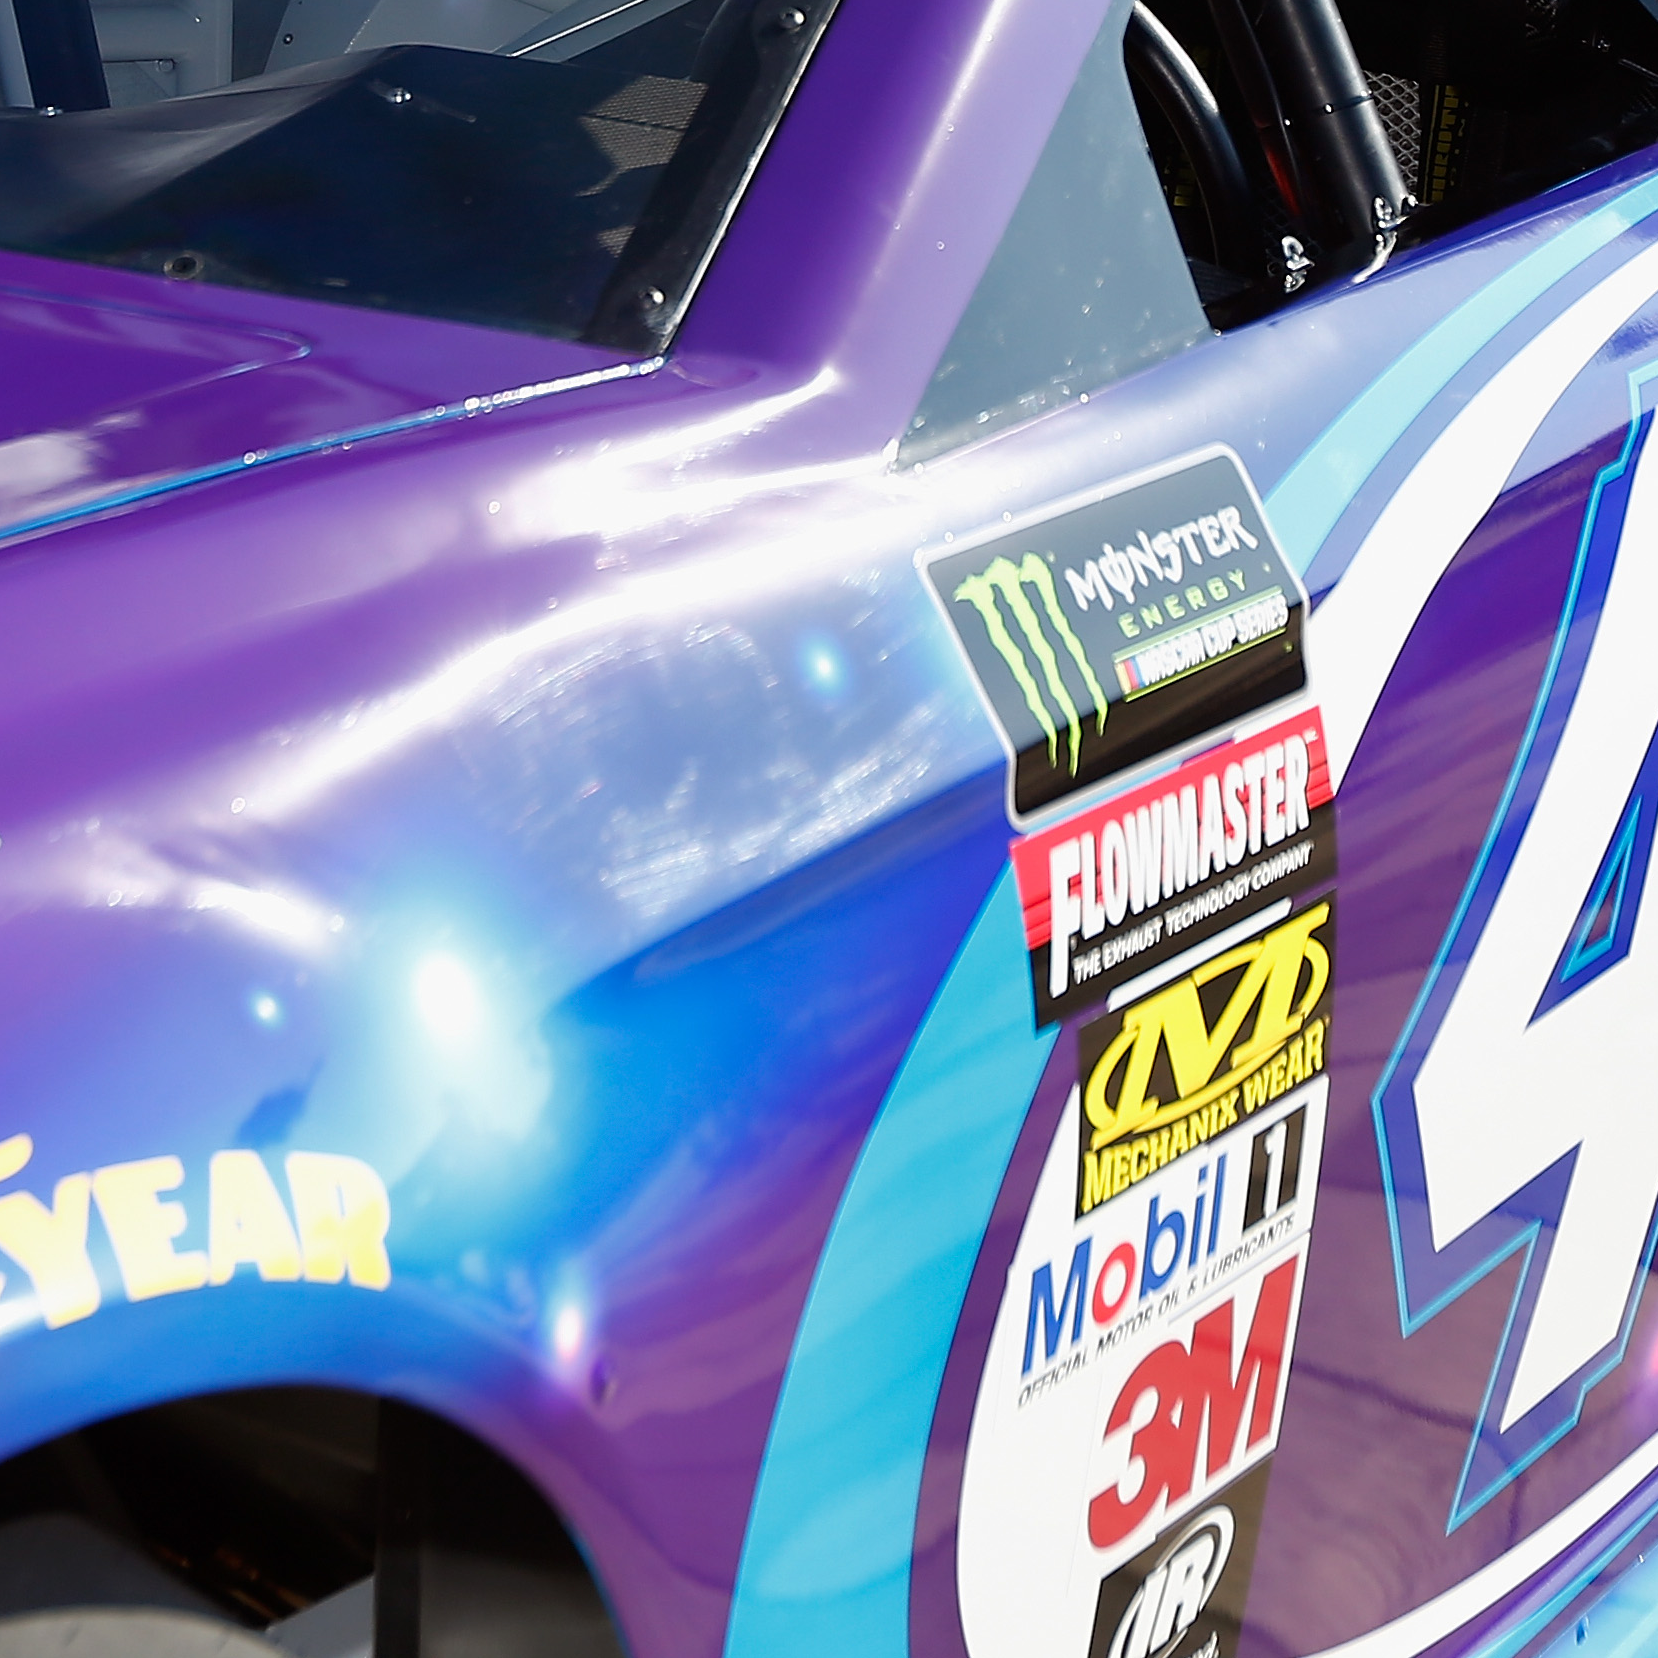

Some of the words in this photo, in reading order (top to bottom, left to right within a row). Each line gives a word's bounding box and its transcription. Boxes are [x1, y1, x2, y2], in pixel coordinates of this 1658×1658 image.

[1064, 505, 1259, 612] MONSTER
[1118, 567, 1248, 639] ENERGY
[1138, 627, 1207, 686] NASCAR
[1200, 614, 1236, 658] CUP
[1234, 591, 1290, 645] SERIES
[1049, 734, 1310, 999] FLOWMASTER
[1072, 952, 1102, 985] THE
[1101, 915, 1164, 969] EXHAUST
[1165, 872, 1252, 937] TECHNOLOGY
[1251, 840, 1314, 894] COMPANY
[1081, 1088, 1240, 1214] MECHANIX
[1243, 1018, 1325, 1115] WEAR
[1017, 1347, 1090, 1409] OFFICIAL
[1096, 1309, 1153, 1360] MOTOR
[1158, 1292, 1180, 1317] OIL
[1203, 1212, 1295, 1289] LUBRICANTS
[1021, 1150, 1229, 1379] Mobil
[1263, 1120, 1289, 1220] 1
[1088, 1253, 1300, 1554] 3M
